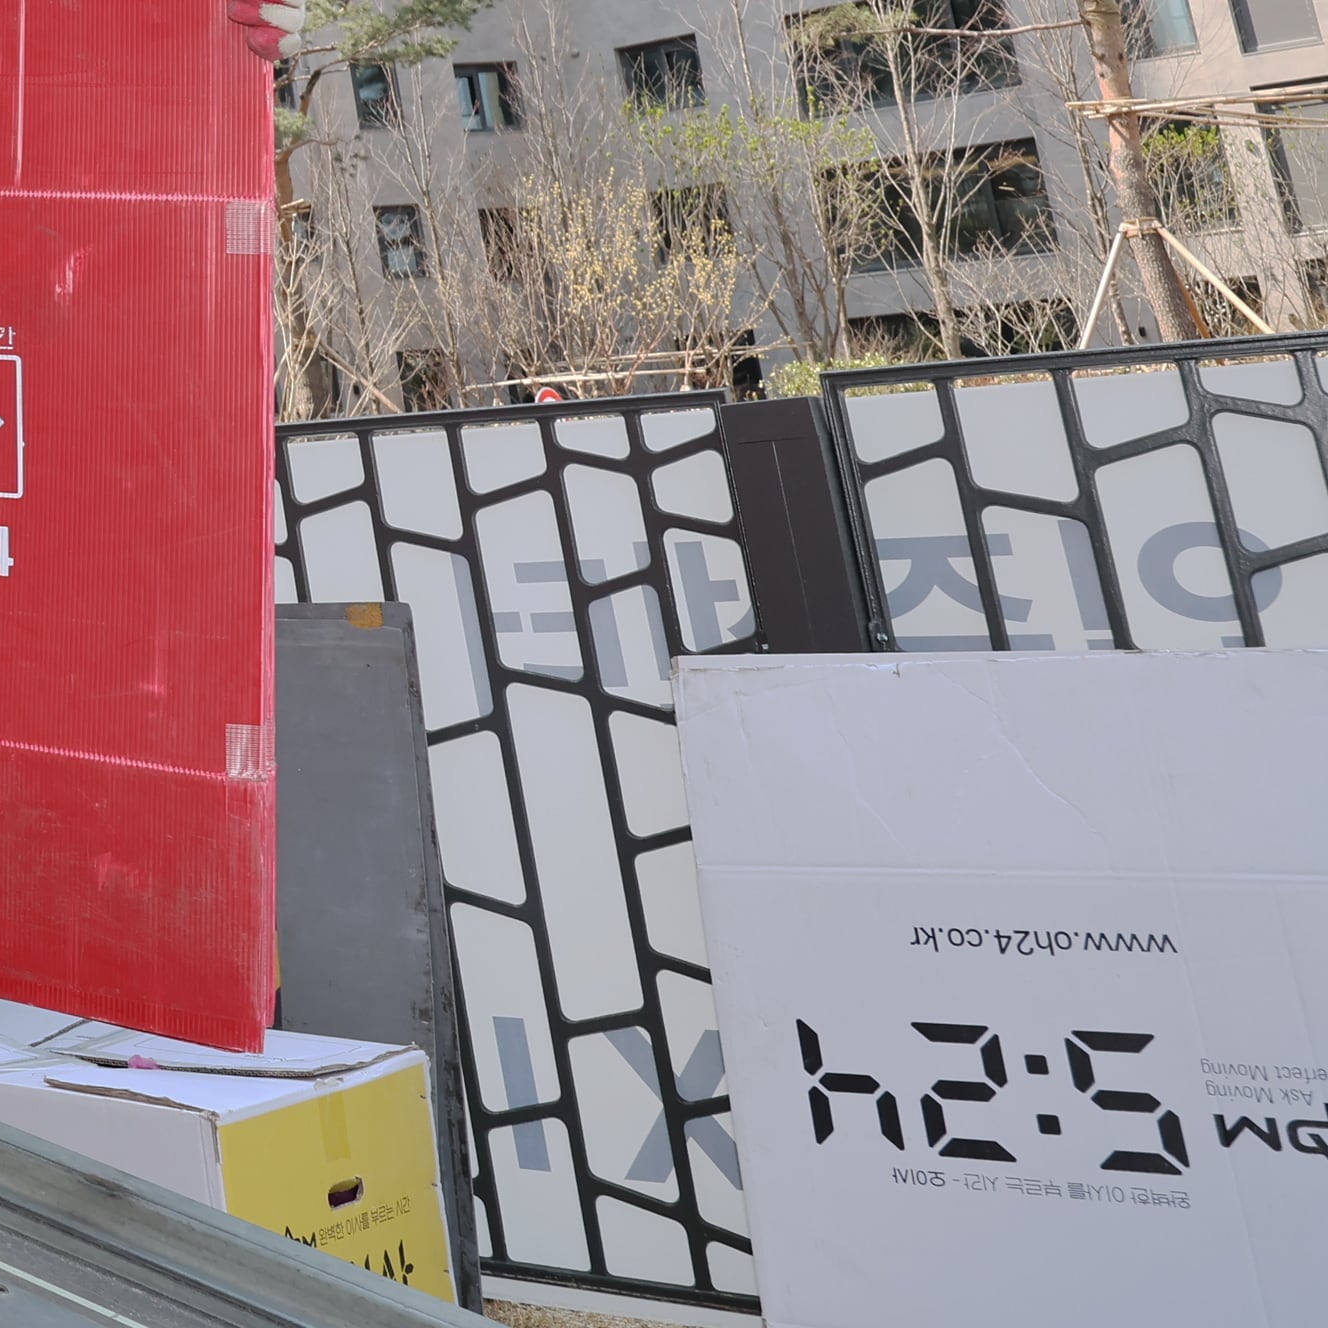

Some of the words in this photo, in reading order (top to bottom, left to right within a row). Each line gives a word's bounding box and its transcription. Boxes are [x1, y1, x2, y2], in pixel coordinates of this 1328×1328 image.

[910, 926, 1179, 957] www.oh24.co.kr
[1200, 1058, 1268, 1082] Moving
[796, 1018, 1190, 1176] 5:24
[1205, 1080, 1274, 1104] Moving
[1281, 1087, 1313, 1106] Ask
[892, 1167, 946, 1187] 오이사
[963, 1173, 999, 1193] 시간
[1005, 1176, 1062, 1197] 부르는
[1066, 1182, 1125, 1203] 이사를
[1130, 1187, 1191, 1209] 완벽한
[318, 1222, 344, 1246] 완벽한
[345, 1212, 370, 1235] 이사를
[370, 1205, 395, 1226] 부르는
[396, 1195, 411, 1216] 시간
